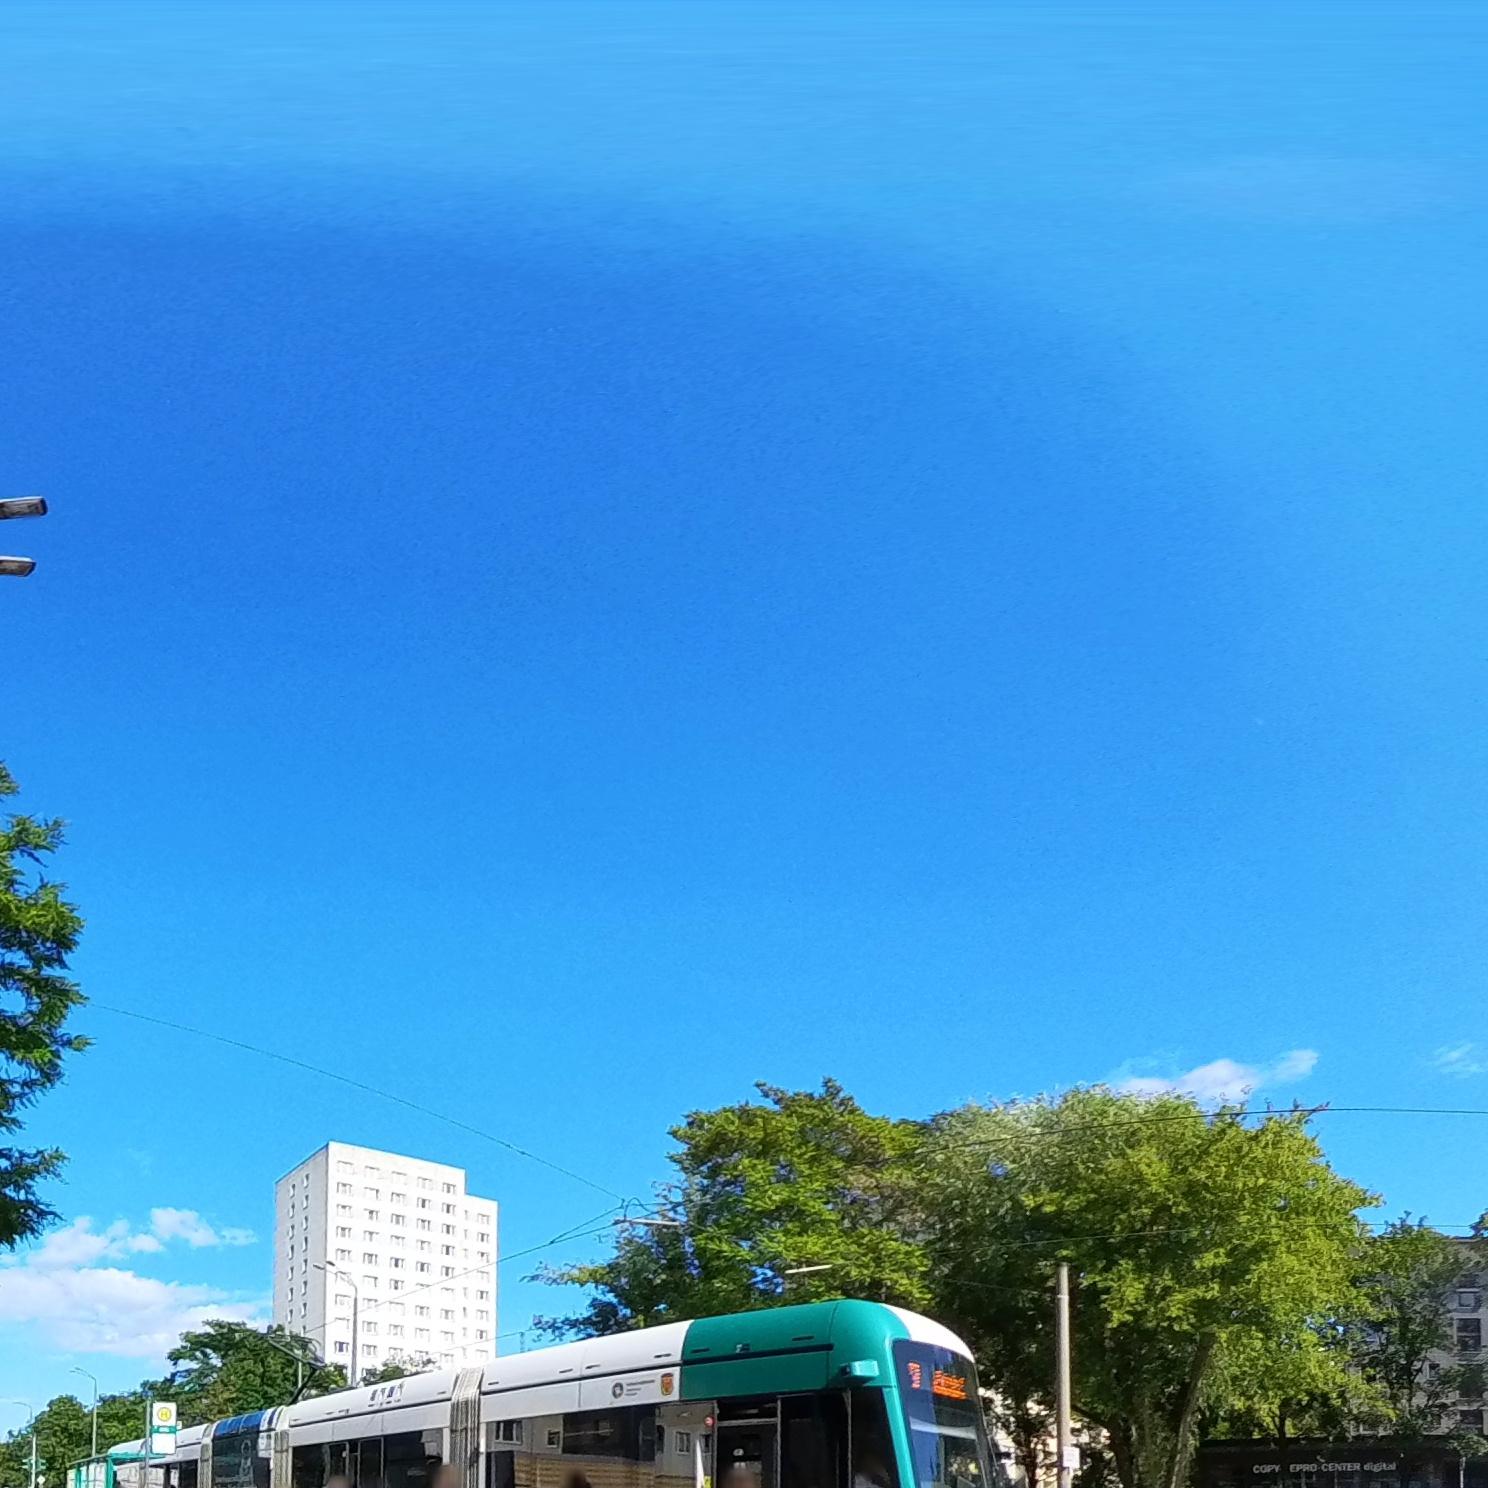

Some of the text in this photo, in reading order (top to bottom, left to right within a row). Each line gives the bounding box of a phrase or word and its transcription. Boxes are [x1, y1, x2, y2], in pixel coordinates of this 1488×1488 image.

[1252, 1461, 1397, 1473] COPY EPRO-CENTER digital
